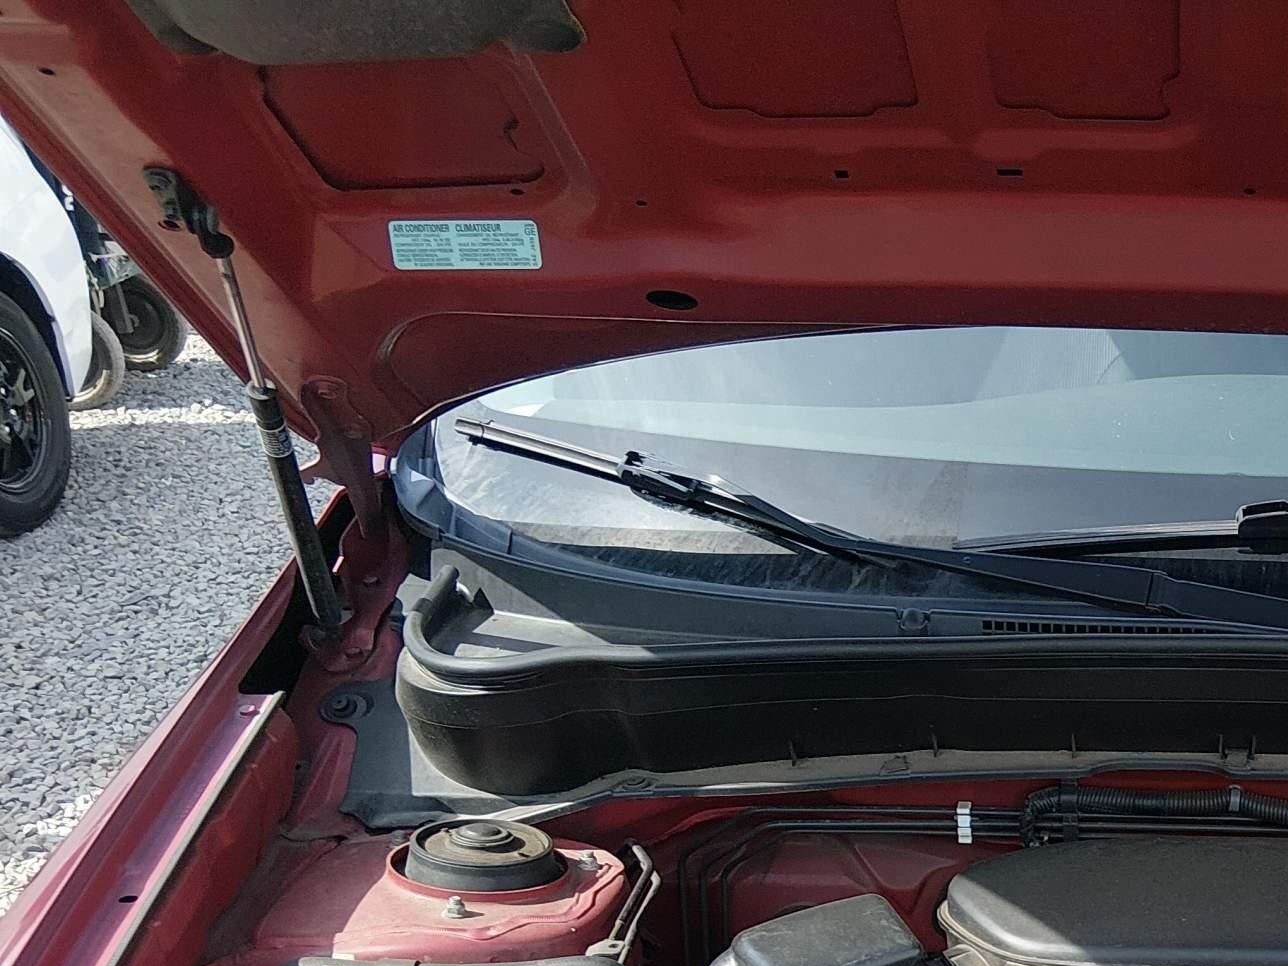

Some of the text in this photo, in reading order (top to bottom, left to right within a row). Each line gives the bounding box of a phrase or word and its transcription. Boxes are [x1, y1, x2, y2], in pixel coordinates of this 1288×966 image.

[392, 223, 450, 233] AIR CONDITIONER
[454, 223, 502, 232] CLIMATISEUR
